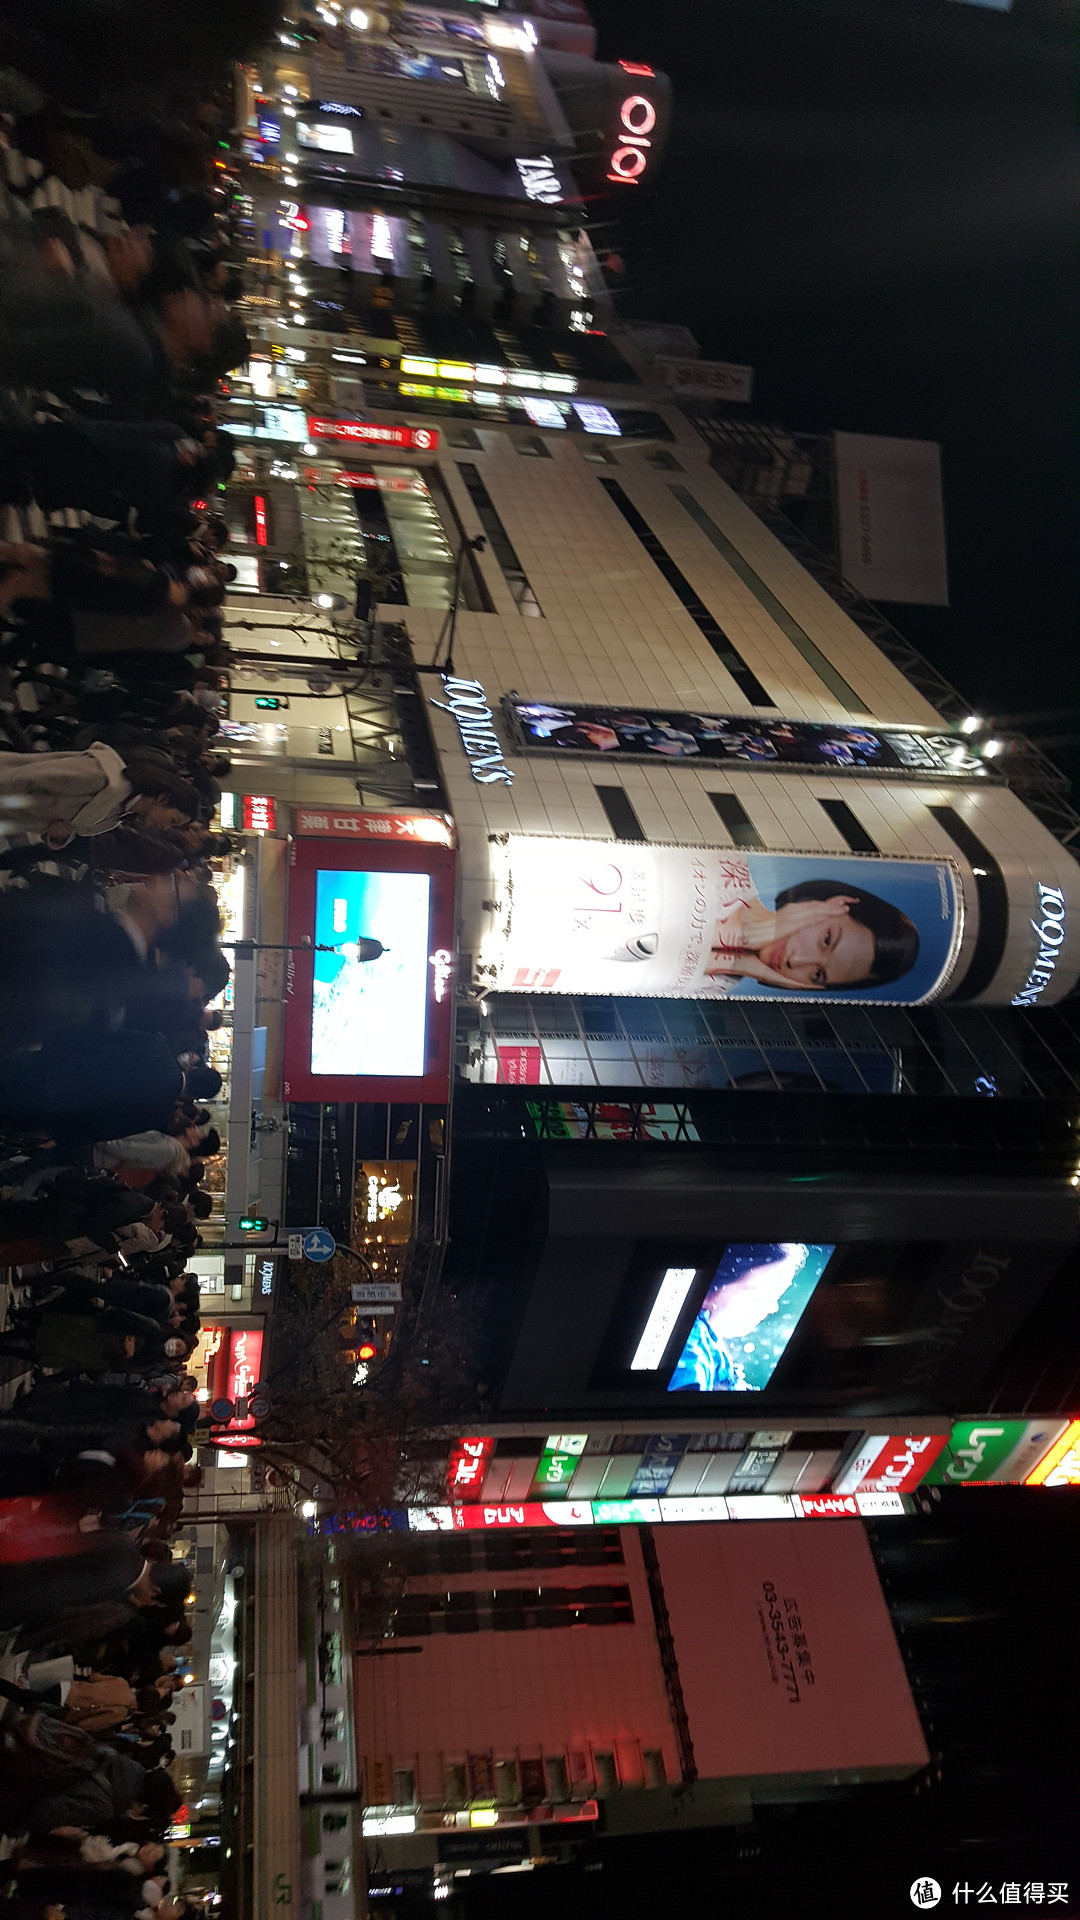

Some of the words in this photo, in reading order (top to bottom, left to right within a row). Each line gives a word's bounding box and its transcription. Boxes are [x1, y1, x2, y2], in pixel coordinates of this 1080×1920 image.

[429, 949, 451, 1003] Glico
[366, 1176, 379, 1222] COFFEE
[546, 1456, 568, 1482] レイク
[875, 1436, 931, 1492] アイフル
[946, 1428, 1005, 1480] レイク
[483, 1507, 524, 1524] アコム
[598, 1503, 635, 1520] レイク
[802, 1499, 845, 1514] アイフル
[762, 1581, 801, 1704] 03-3543-7771
[274, 1873, 293, 1906] JR
